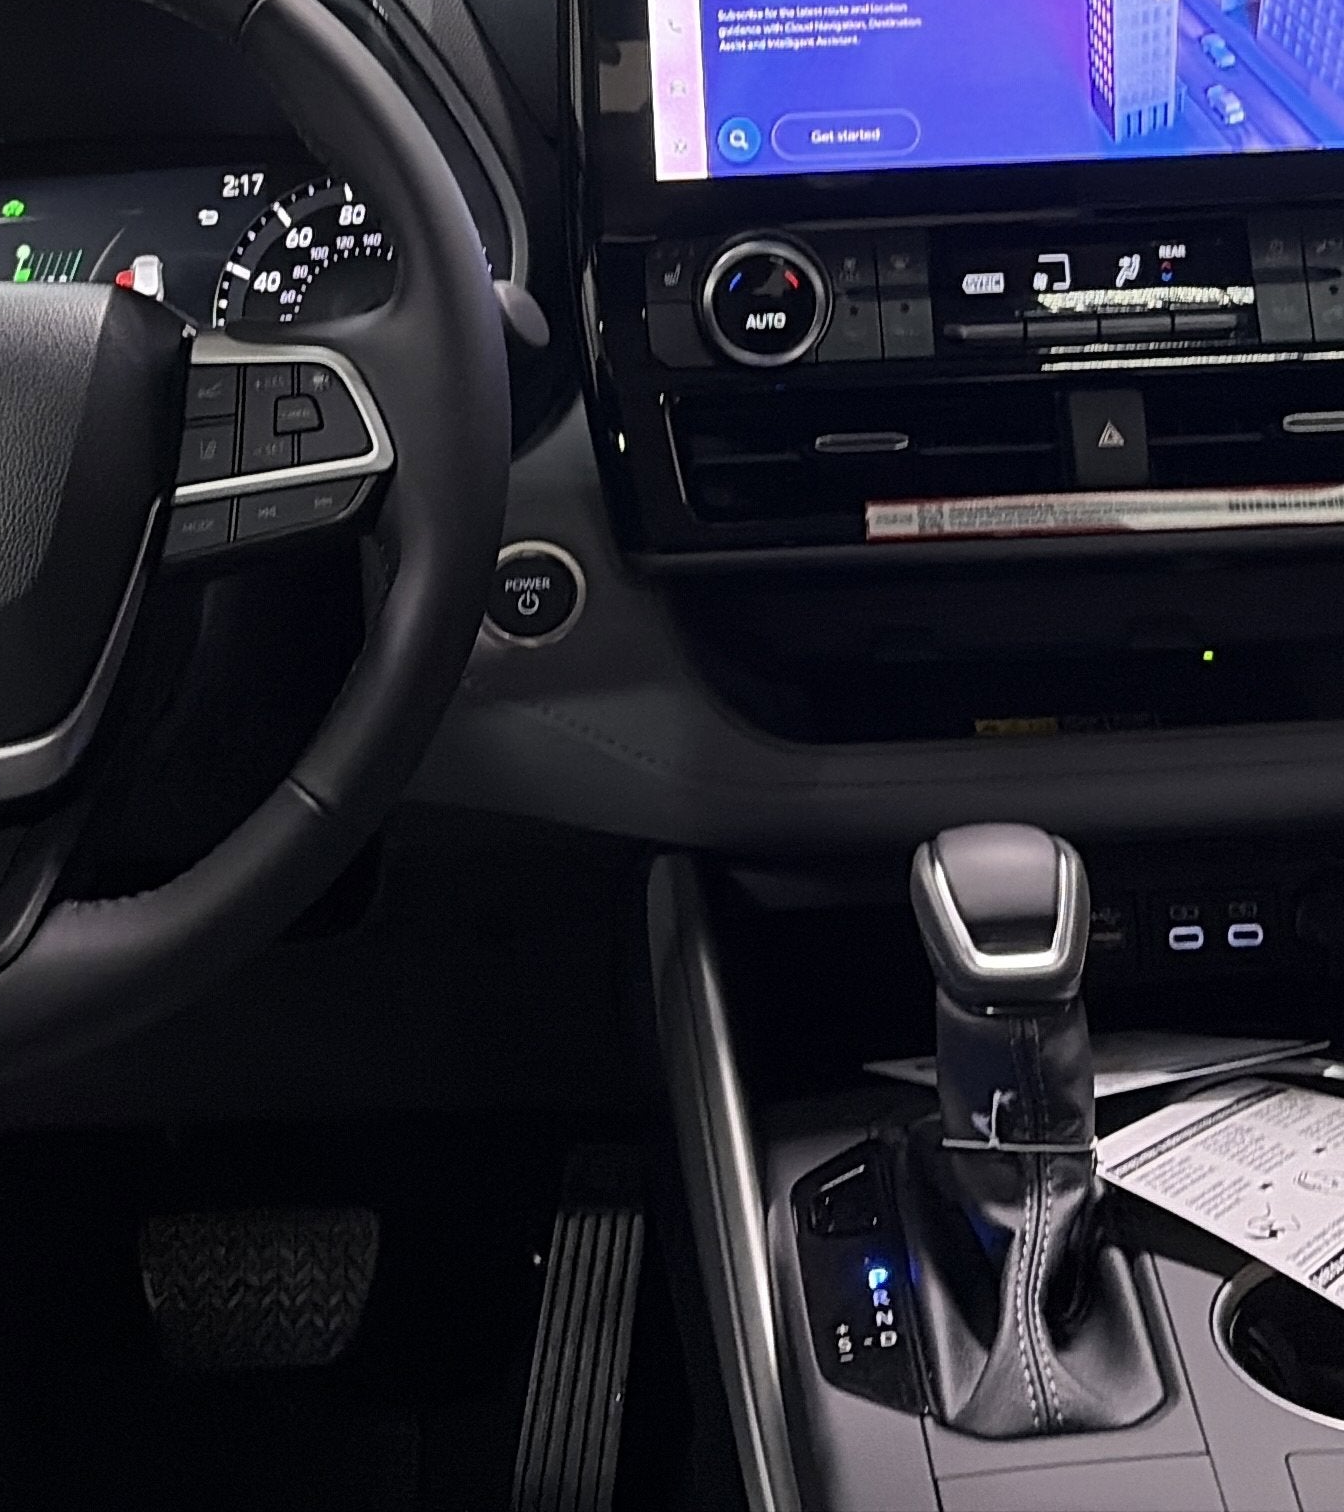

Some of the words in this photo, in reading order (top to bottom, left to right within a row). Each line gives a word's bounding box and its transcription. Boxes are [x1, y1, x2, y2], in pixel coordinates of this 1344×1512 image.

[811, 129, 834, 144] Get
[837, 127, 881, 143] started
[222, 173, 264, 198] 2:17
[338, 203, 367, 226] 80
[285, 226, 313, 249] 60
[362, 232, 382, 247] 140
[310, 246, 329, 260] 100
[1158, 245, 1187, 259] REAR
[292, 265, 309, 279] 80
[254, 271, 281, 293] 40
[280, 289, 296, 304] 60
[746, 311, 786, 330] AUTO
[504, 576, 551, 593] POWER
[868, 1268, 888, 1290] P
[872, 1289, 891, 1307] R
[876, 1309, 894, 1327] N
[880, 1330, 897, 1348] D
